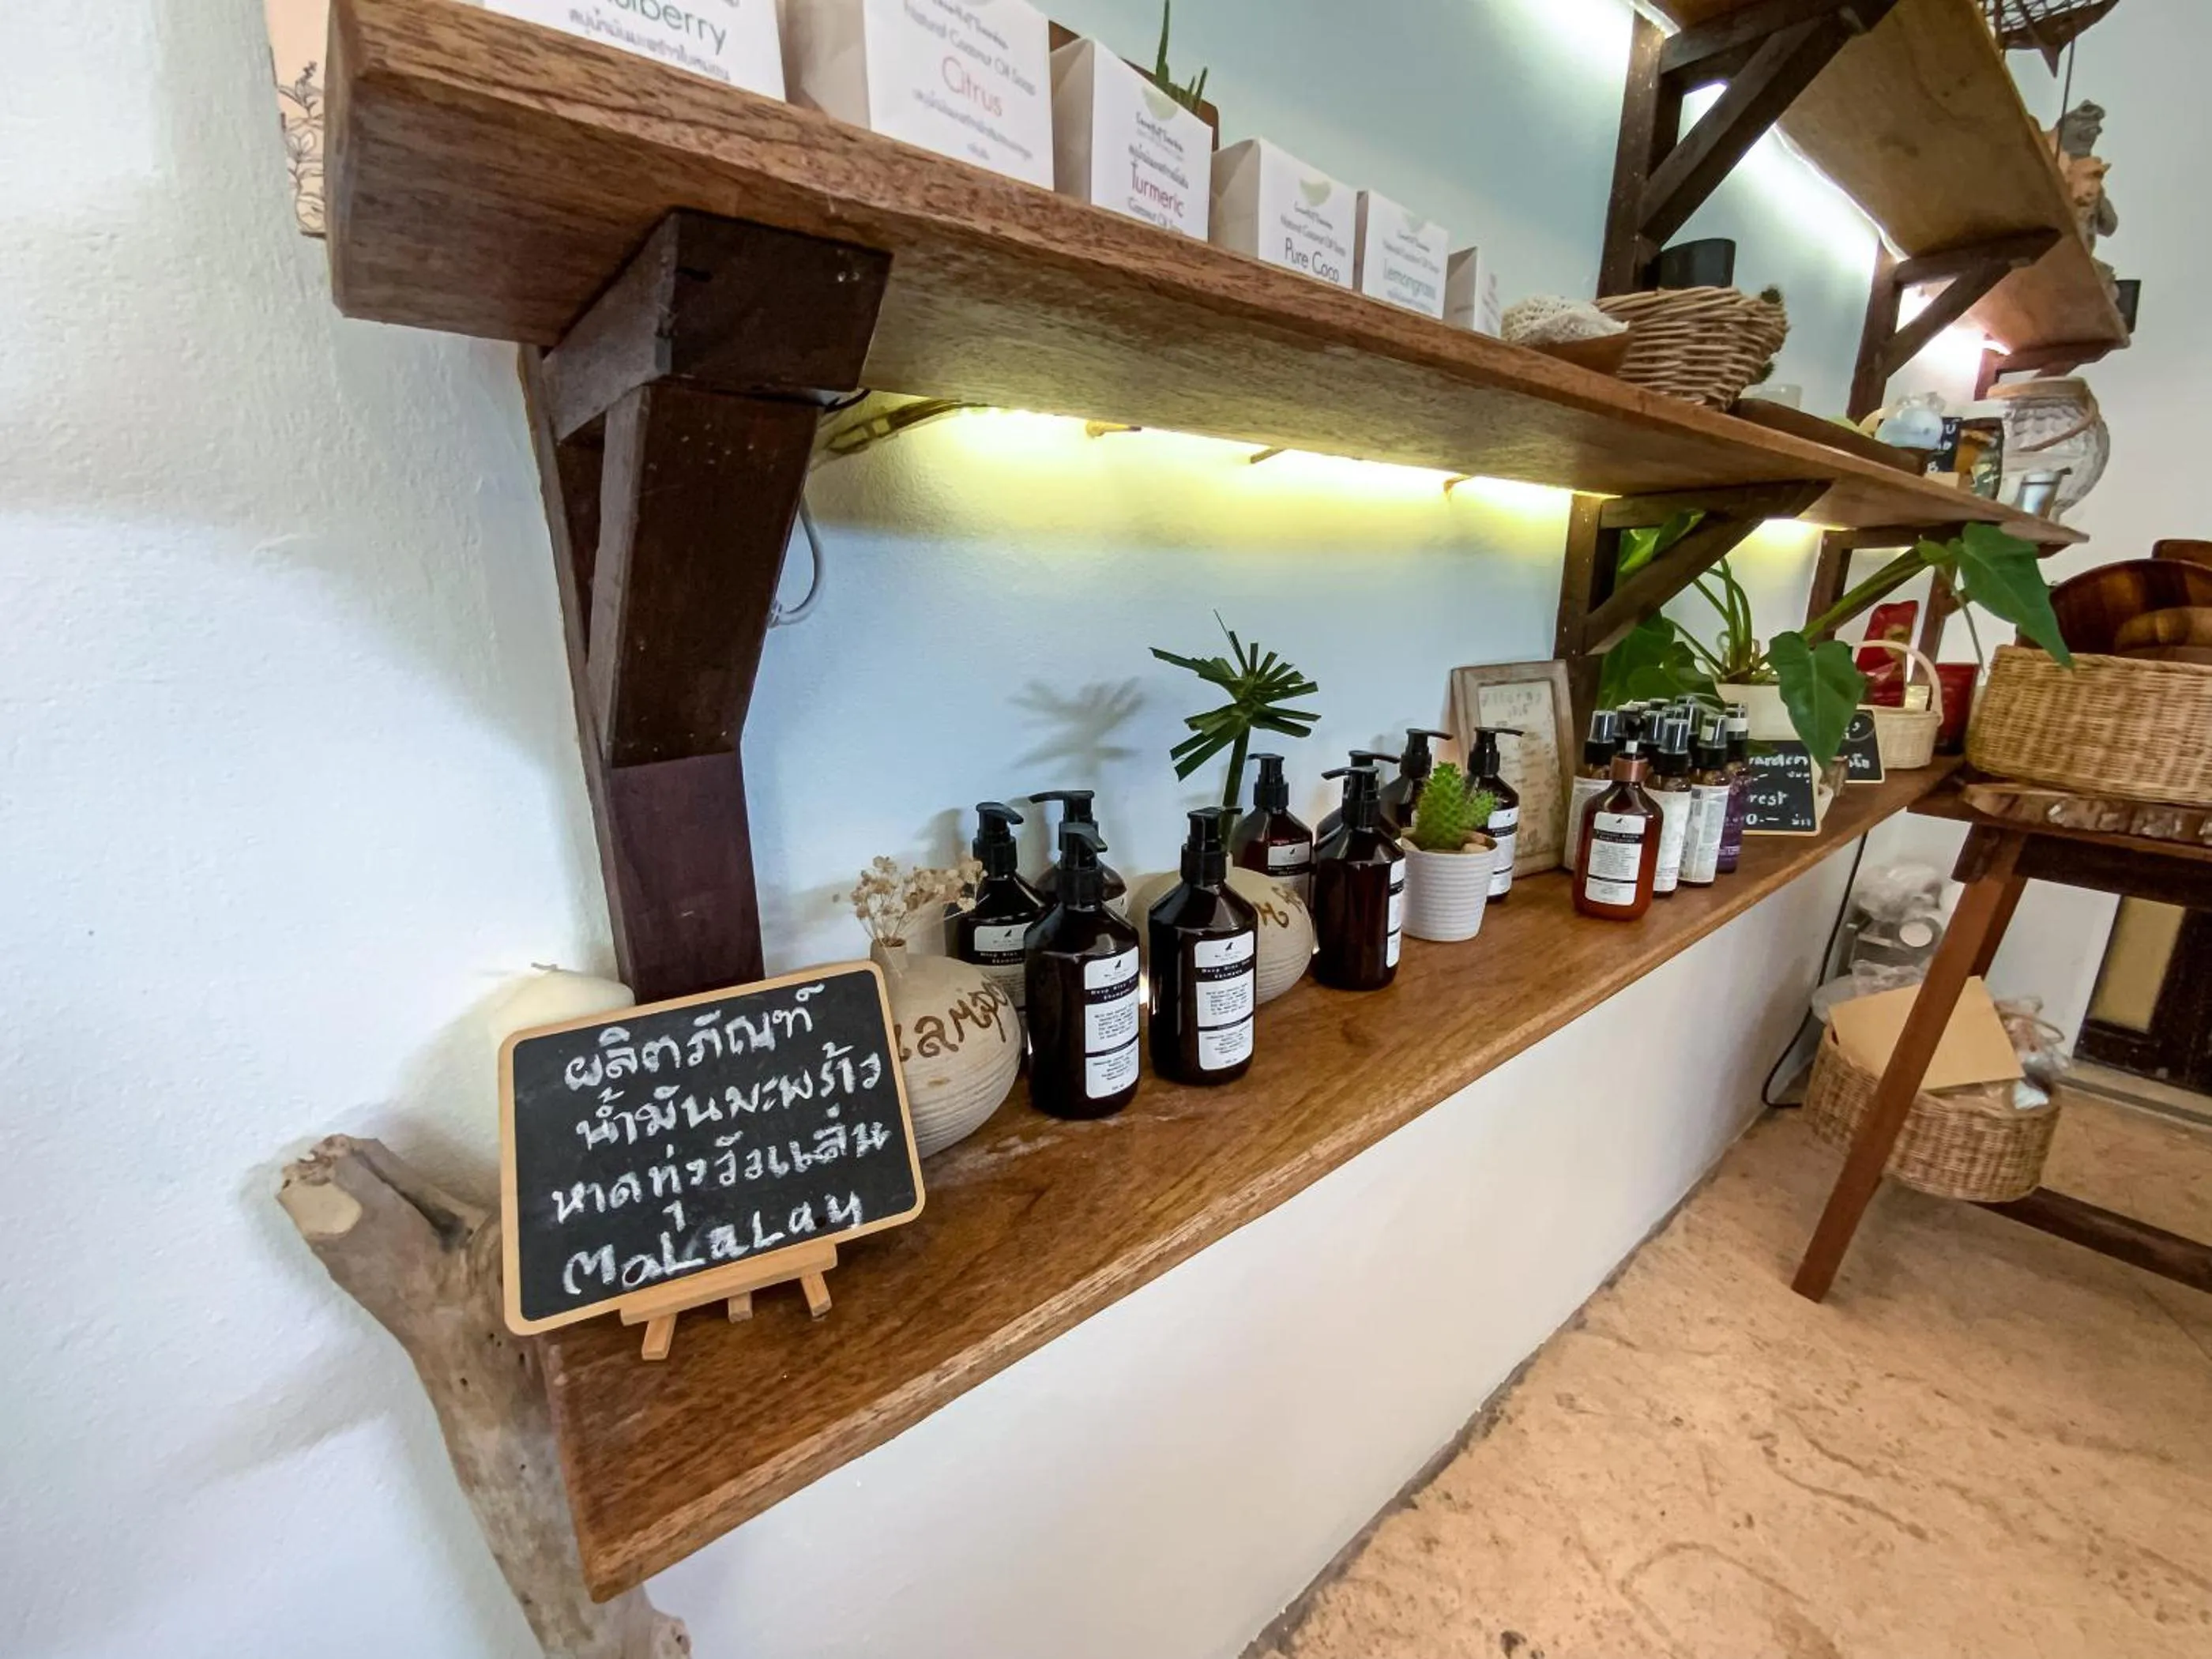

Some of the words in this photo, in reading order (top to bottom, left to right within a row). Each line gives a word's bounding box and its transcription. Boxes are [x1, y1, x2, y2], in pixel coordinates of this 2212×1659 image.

[942, 56, 1003, 118] Citrus
[1130, 160, 1184, 219] Turmeric
[1285, 237, 1309, 269] Pure
[1312, 251, 1340, 283] Coco
